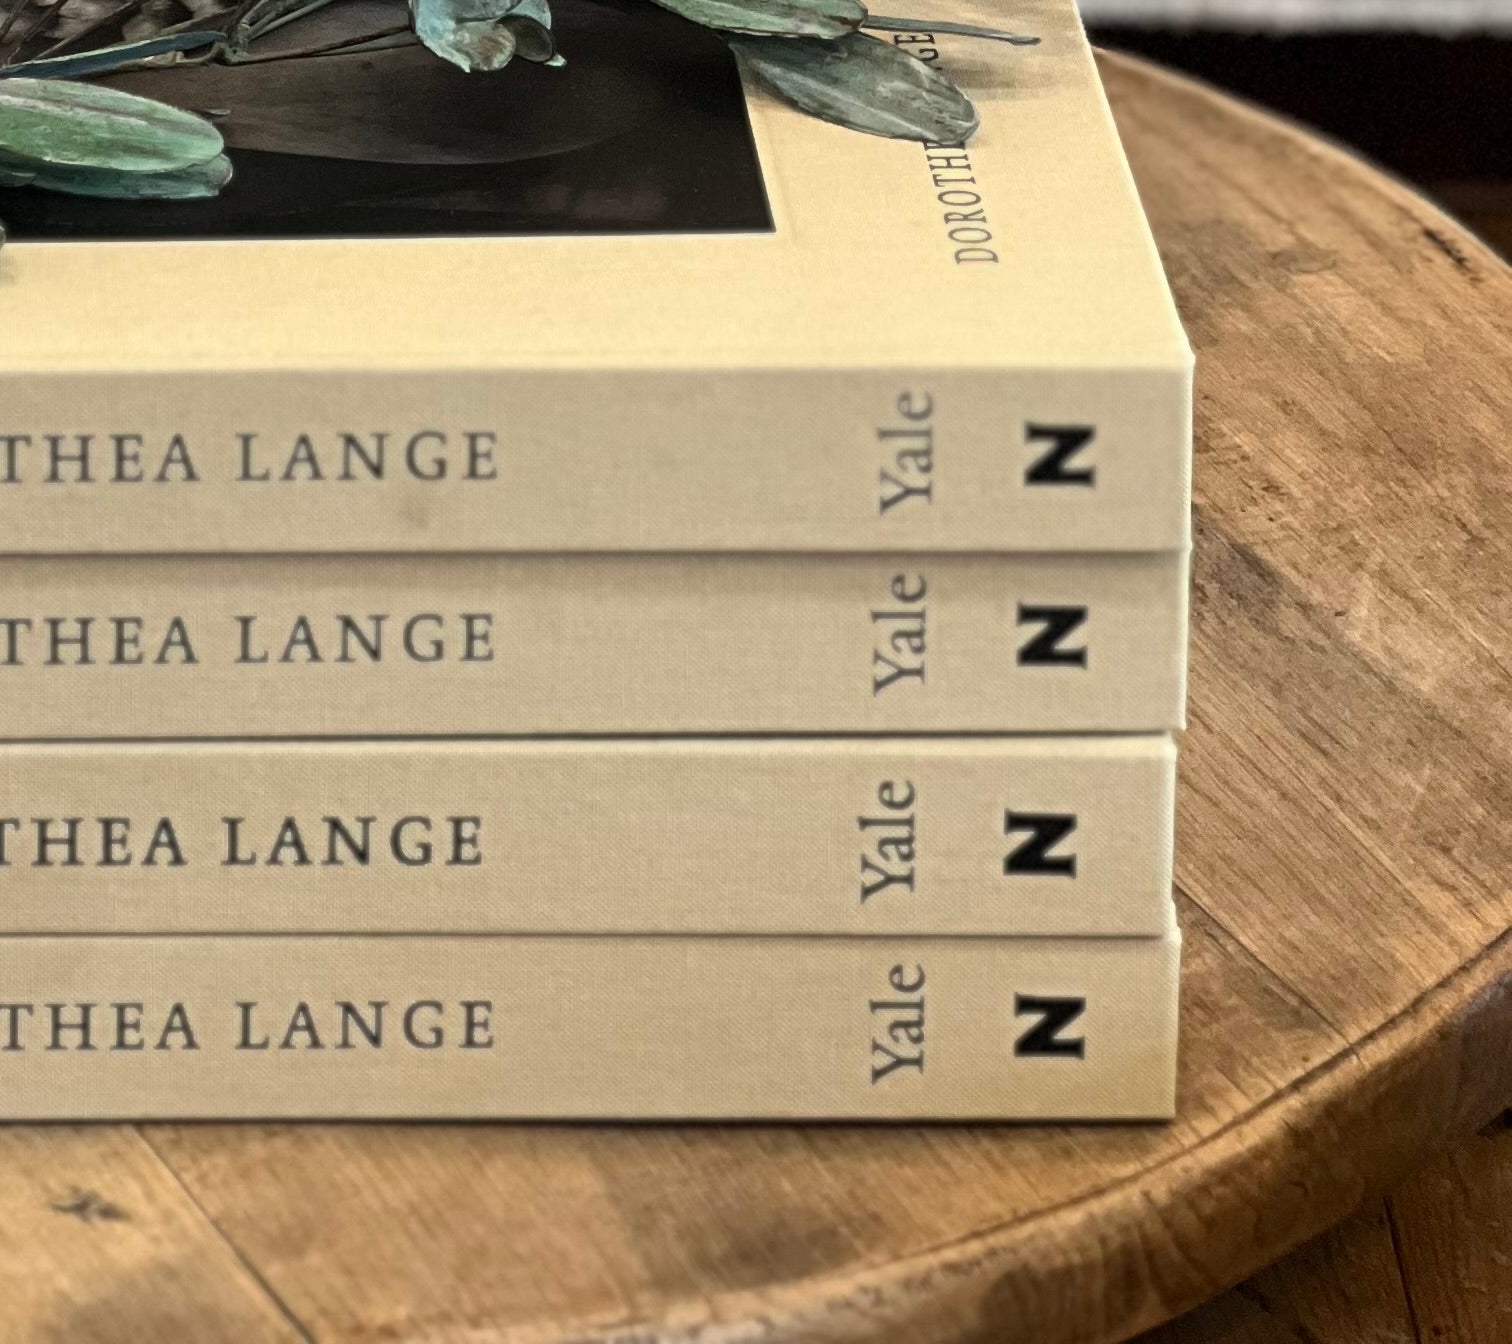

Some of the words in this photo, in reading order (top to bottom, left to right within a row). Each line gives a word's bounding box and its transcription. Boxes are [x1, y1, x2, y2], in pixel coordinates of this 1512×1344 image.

[923, 140, 999, 265] DOROTH
[234, 429, 499, 483] LANGE
[876, 390, 934, 516] Yale
[232, 612, 495, 665] LANGE
[870, 571, 928, 697] Yale
[219, 815, 485, 868] LANGE
[856, 779, 917, 906] Yale
[234, 999, 496, 1052] LANGE
[868, 962, 927, 1086] Yale
